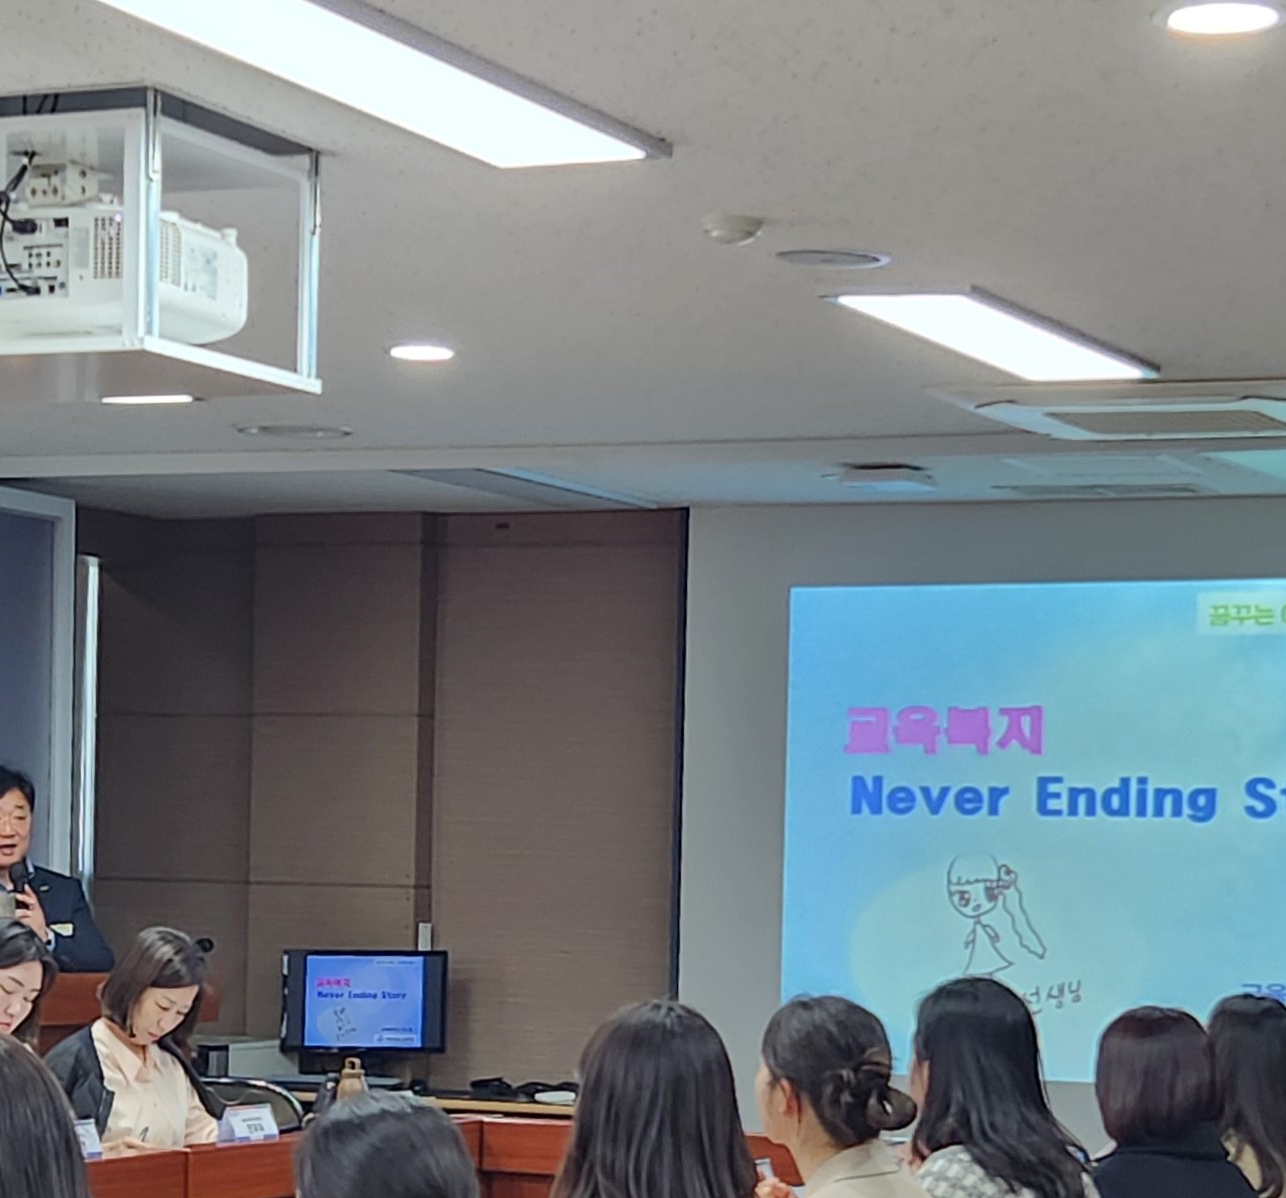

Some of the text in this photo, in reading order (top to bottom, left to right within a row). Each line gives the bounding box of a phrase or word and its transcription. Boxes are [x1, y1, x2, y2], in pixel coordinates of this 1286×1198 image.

[843, 704, 1043, 755] 교육복지
[850, 775, 1010, 817] Never
[1036, 776, 1218, 823] Ending
